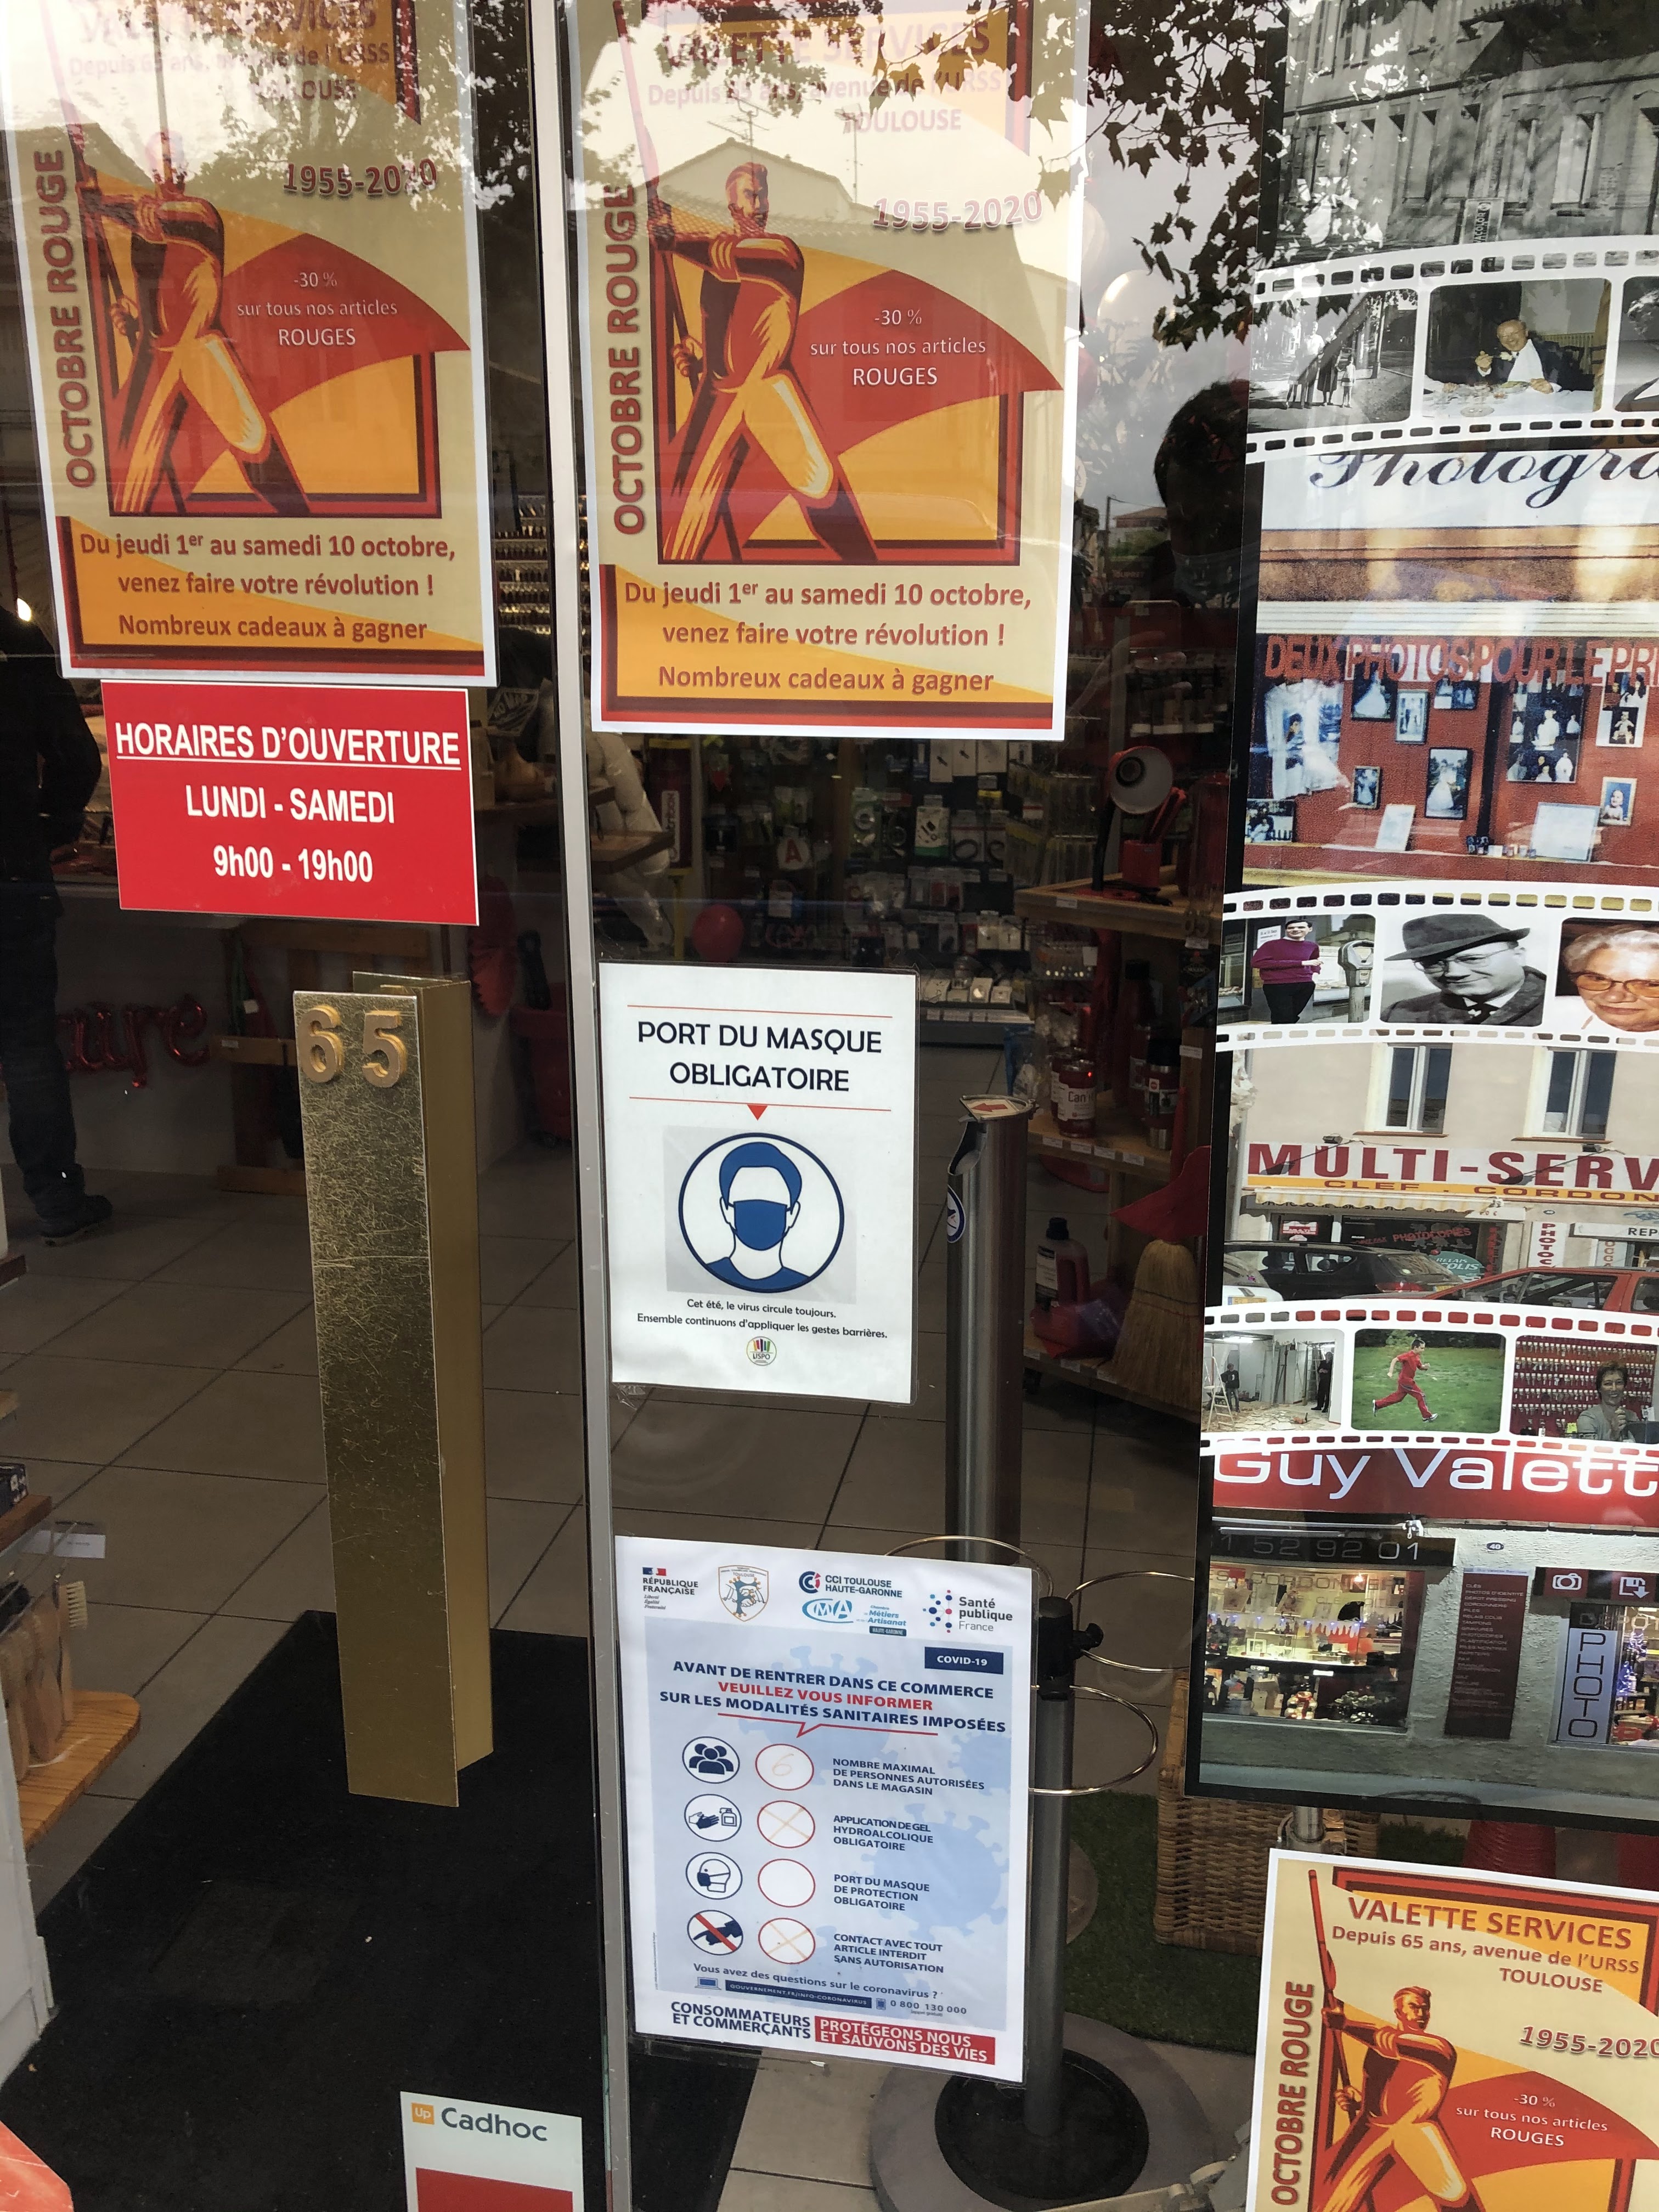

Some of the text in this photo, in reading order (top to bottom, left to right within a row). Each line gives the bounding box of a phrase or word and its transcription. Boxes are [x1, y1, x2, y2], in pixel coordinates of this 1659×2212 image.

[845, 109, 961, 134] TOULOUSE
[283, 159, 438, 197] 1955-2020
[873, 190, 1042, 232] 1955-2020
[34, 150, 95, 489] OCTOBRE ROUGE
[874, 309, 901, 325] -30
[810, 337, 986, 356] sur tous nos articles
[604, 184, 645, 535] OCTOBRE ROUGE
[853, 367, 938, 385] ROUGES
[624, 582, 1031, 610] Du jeudi au samedi 10 octobre,
[119, 614, 427, 642] Nombreux cadeaux gagner
[663, 622, 988, 646] venez faire votre révolution
[1265, 634, 1604, 686] DEUX PHOTOS POUR LE
[115, 723, 460, 764] HORAIRES D'OUVERTURE
[186, 785, 394, 823] LUNDI SAMEDI
[213, 845, 373, 883] 9h00 19h00
[298, 1005, 408, 1087] 65
[638, 1021, 882, 1055] PORT DU MASQUE
[670, 1062, 849, 1092] OBLIGATOIRE
[1248, 1142, 1659, 1192] MULTI-SERV
[1324, 1180, 1659, 1201] CLEF CORDON
[1392, 1227, 1471, 1242] PHOTOCOPIES
[687, 1299, 836, 1319] Cet été, le virus circule toujours.
[637, 1313, 888, 1339] Ensemble continuons d'appliquer les gestes barrières.
[1214, 1448, 1659, 1499] Guy Valett
[1253, 1539, 1418, 1560] 52 92 01
[643, 1577, 698, 1587] RÉPUBLIQUE
[643, 1585, 695, 1595] FRANÇAISE
[825, 1575, 892, 1588] CCI TOULOUSE
[825, 1584, 902, 1598] HAUTE-GARONNE
[870, 1610, 899, 1618] Métiers
[959, 1596, 995, 1609] Santé
[867, 1617, 906, 1626] Artisanat
[959, 1609, 1013, 1621] publique
[959, 1621, 994, 1632] France
[937, 1655, 988, 1666] COVID-19
[673, 1661, 994, 1699] AVANT DE RENTRER DANS CE COMMERCE
[1567, 1631, 1606, 1739] PHOTO
[718, 1681, 933, 1711] VEUILLEZ VOUS INFORMER
[660, 1690, 1006, 1733] SUR LES MODALITÉS SANITAIRES IMPOSÉES
[833, 1758, 935, 1774] NOMBRE MAXIMAL
[833, 1769, 985, 1790] DE PERSONNES AUTORISÉES
[833, 1779, 933, 1795] DANS LE MAGASIN
[833, 1815, 931, 1832] APPLICATION GEL
[833, 1825, 933, 1844] HYDROALCOLIQUE
[833, 1836, 905, 1851] OBLIGATOIRE
[834, 1874, 930, 1892] PORT DU MASQUE
[834, 1884, 919, 1901] DE PROTECTION
[834, 1896, 905, 1911] OBLIGATOIRE
[1348, 1897, 1632, 1950] VALETTE SERVICES
[834, 1934, 943, 1952] CONTACT AVEC TOUT
[834, 1944, 927, 1961] ARTICLE INTERDIT
[1331, 1926, 1395, 1946] Depuis
[1401, 1934, 1423, 1948] 65
[1429, 1939, 1467, 1957] ans,
[1473, 1945, 1542, 1962] avenue
[1548, 1950, 1571, 1965] de
[834, 1955, 944, 1973] SANS AUTORISATION
[693, 1963, 930, 1999] Vous avez des questions sur le coronavirus
[1499, 1967, 1602, 1993] TOULOUSE
[672, 2001, 810, 2027] CONSOMMATEURS
[926, 2004, 944, 2012] 130
[947, 2007, 967, 2015] 000
[673, 2013, 811, 2039] ET COMMERÇANTS
[820, 2018, 972, 2047] PROTÉGEONS NOUS
[821, 2031, 988, 2061] ET SAUVONS DES VIES
[1520, 2025, 1659, 2057] 1955-2020
[1271, 1982, 1314, 2205] OCTOBRE ROUGE
[415, 2107, 548, 2141] Up Cadhoc
[1490, 2126, 1564, 2147] ROUGES
